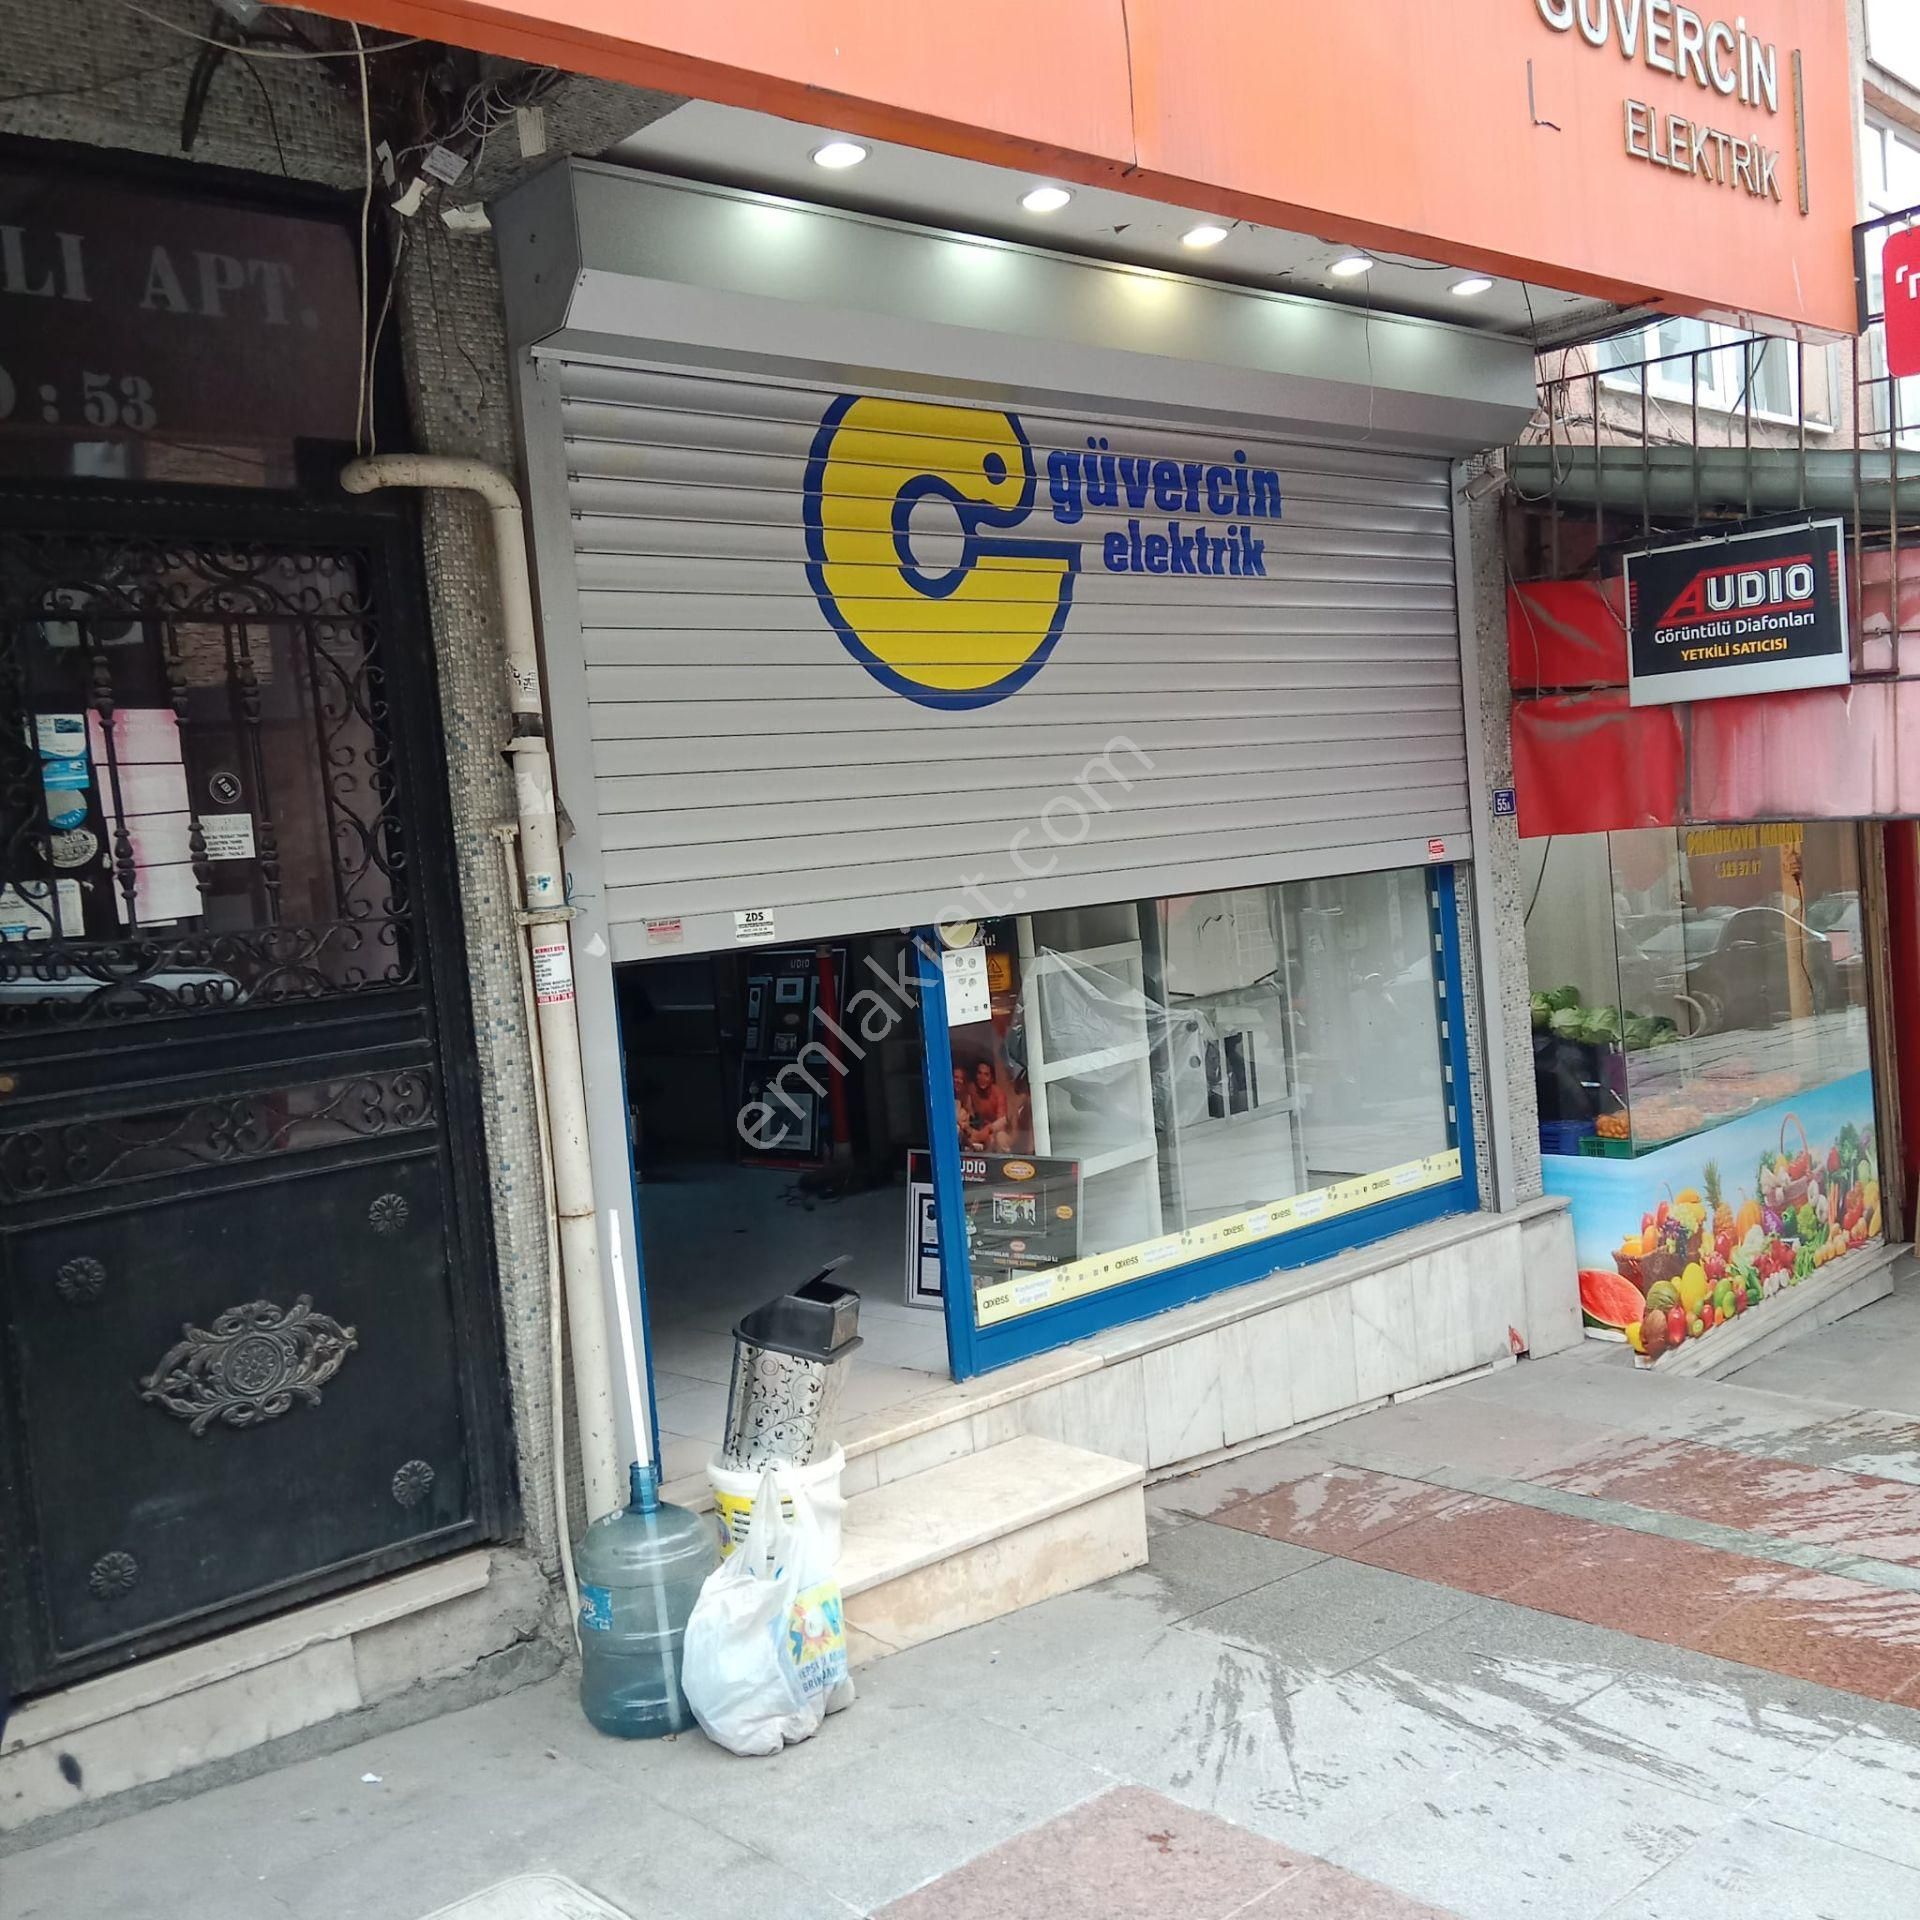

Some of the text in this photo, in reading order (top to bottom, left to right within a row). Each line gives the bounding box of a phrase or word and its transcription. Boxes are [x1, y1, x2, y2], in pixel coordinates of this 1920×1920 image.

[1623, 98, 1782, 202] ELEKTRİK
[139, 245, 319, 331] APT.
[82, 370, 158, 431] 53
[1047, 436, 1282, 525] güvercin
[1103, 519, 1267, 576] elektrik
[1659, 560, 1814, 625] AUDIO
[1654, 612, 1816, 645] Görüntülü Diafonları
[1681, 637, 1788, 662] YETKİLİ SATICISI
[745, 911, 764, 922] ZDS
[983, 1295, 1010, 1309] axess
